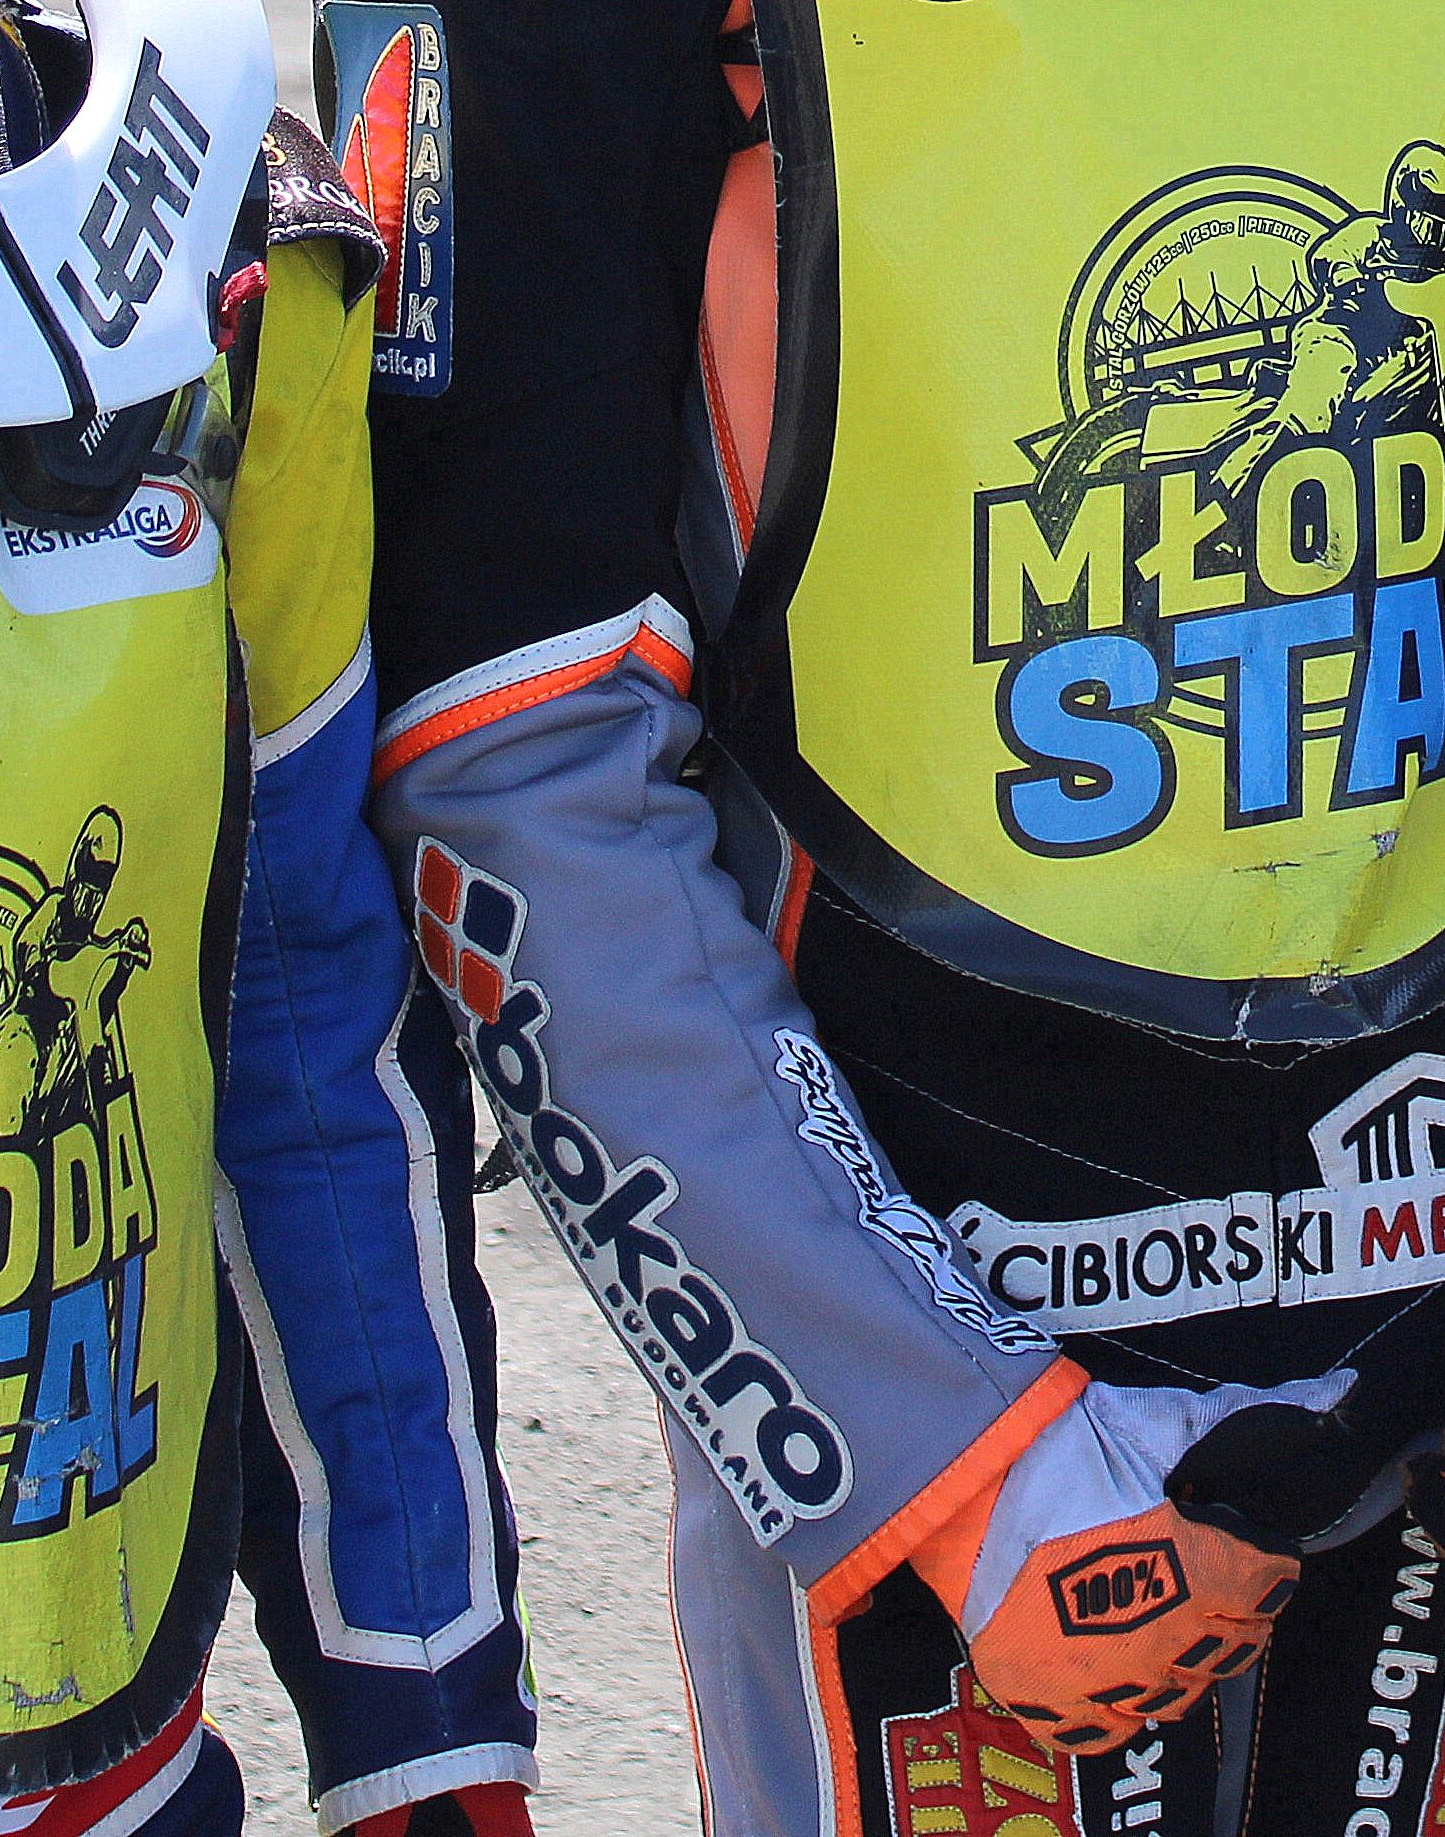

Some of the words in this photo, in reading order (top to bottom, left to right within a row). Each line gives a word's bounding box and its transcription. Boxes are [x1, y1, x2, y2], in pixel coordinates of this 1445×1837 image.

[57, 37, 213, 350] LEATT
[405, 23, 443, 343] BRACIK
[475, 986, 844, 1508] bokaro
[605, 1280, 786, 1536] BUDOWLANE
[1071, 1555, 1165, 1620] 100%
